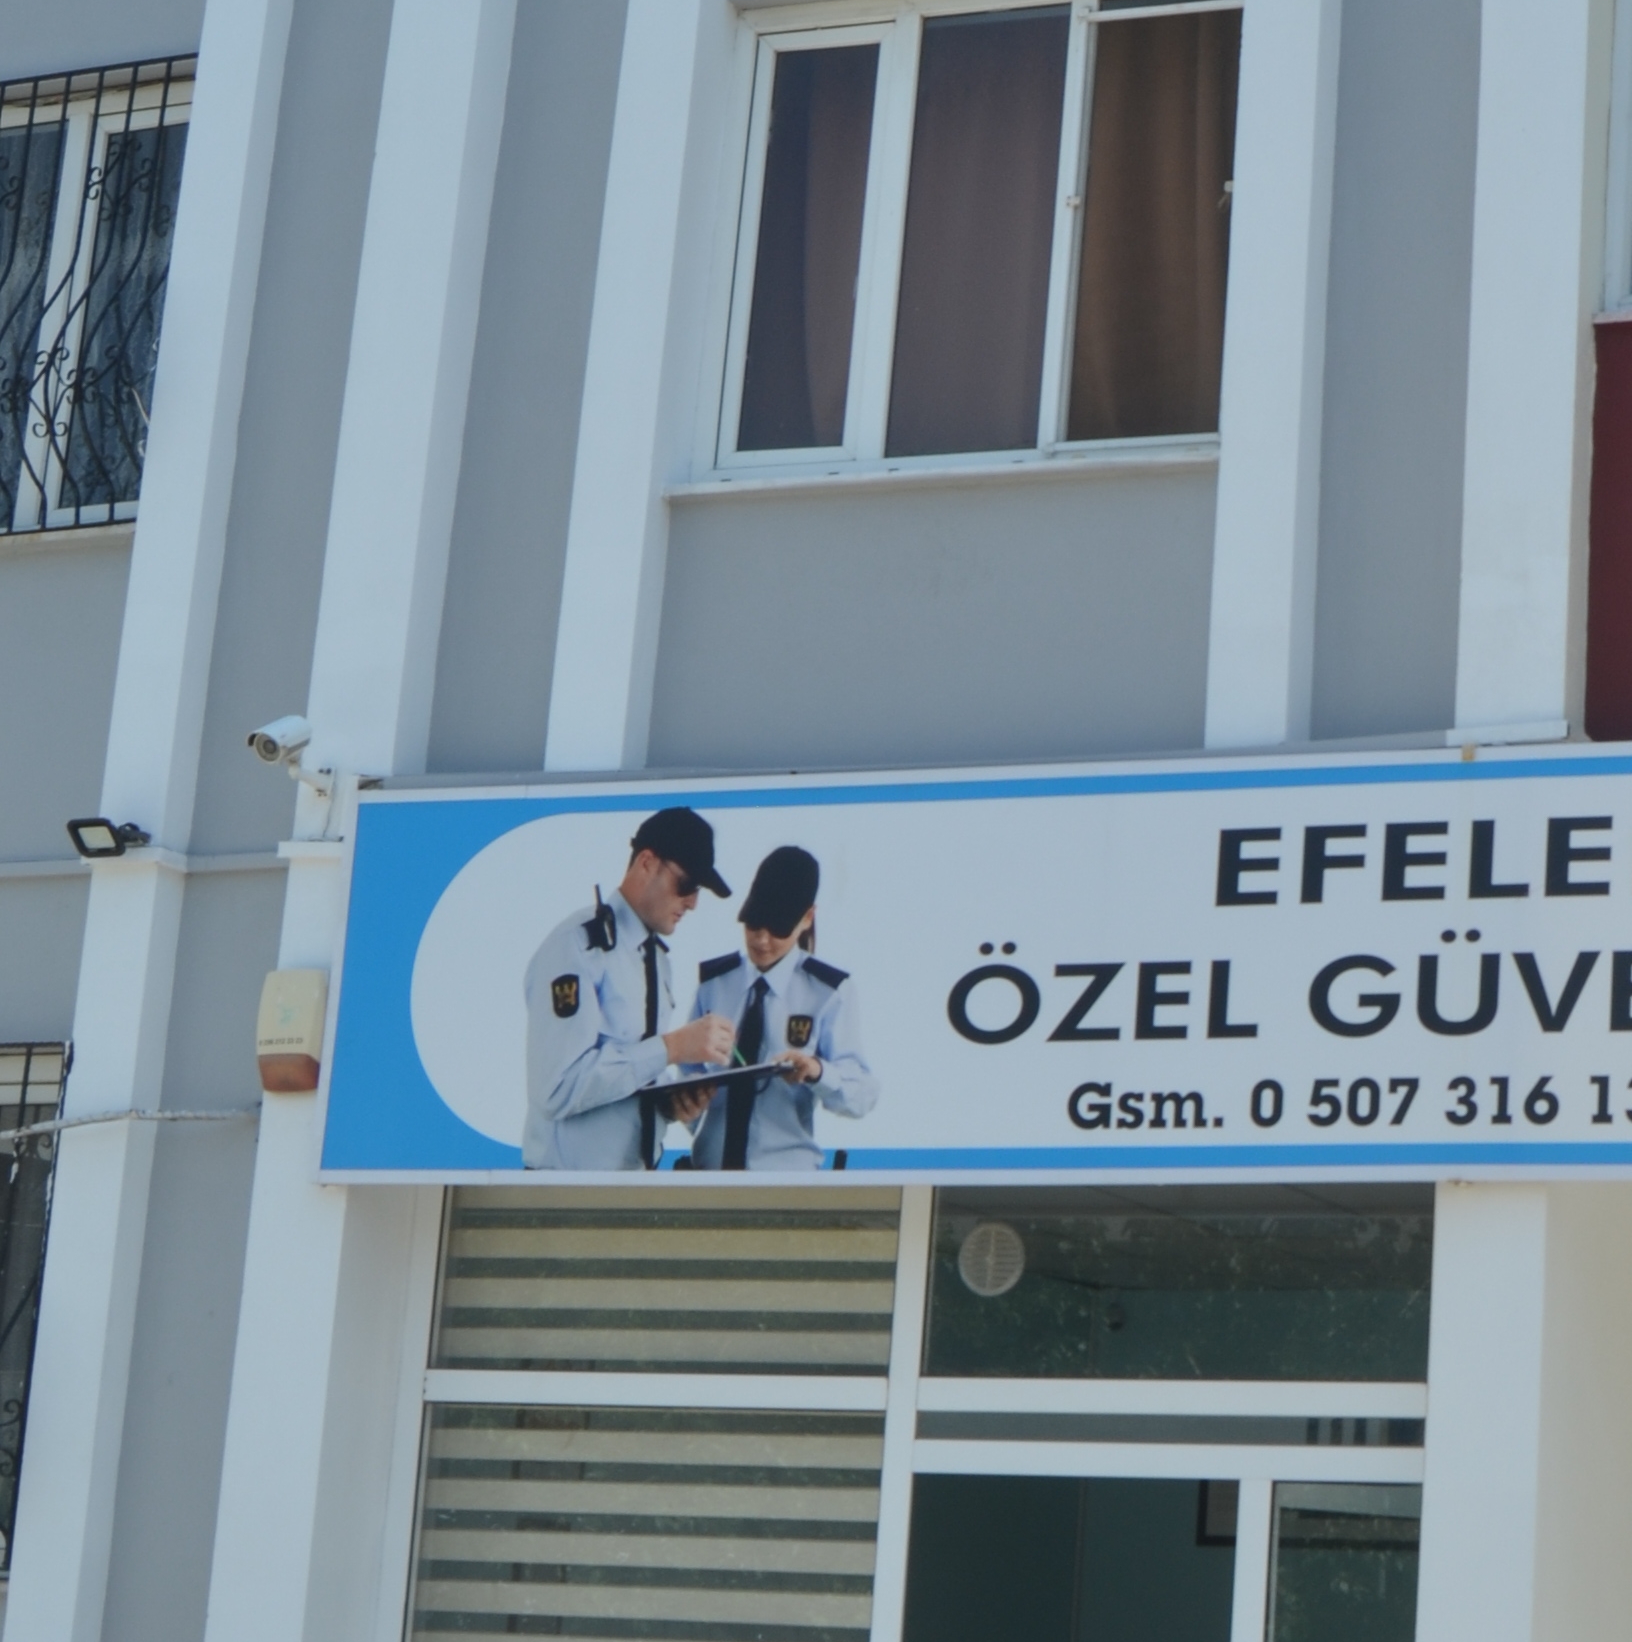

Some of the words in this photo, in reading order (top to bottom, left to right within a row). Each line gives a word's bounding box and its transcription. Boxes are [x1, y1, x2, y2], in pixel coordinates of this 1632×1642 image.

[946, 940, 1259, 1046] ÖZEL
[1067, 1081, 1225, 1131] Gsm.
[1250, 1079, 1284, 1128] 0
[1308, 1077, 1420, 1127] 507
[1445, 1076, 1559, 1126] 316
